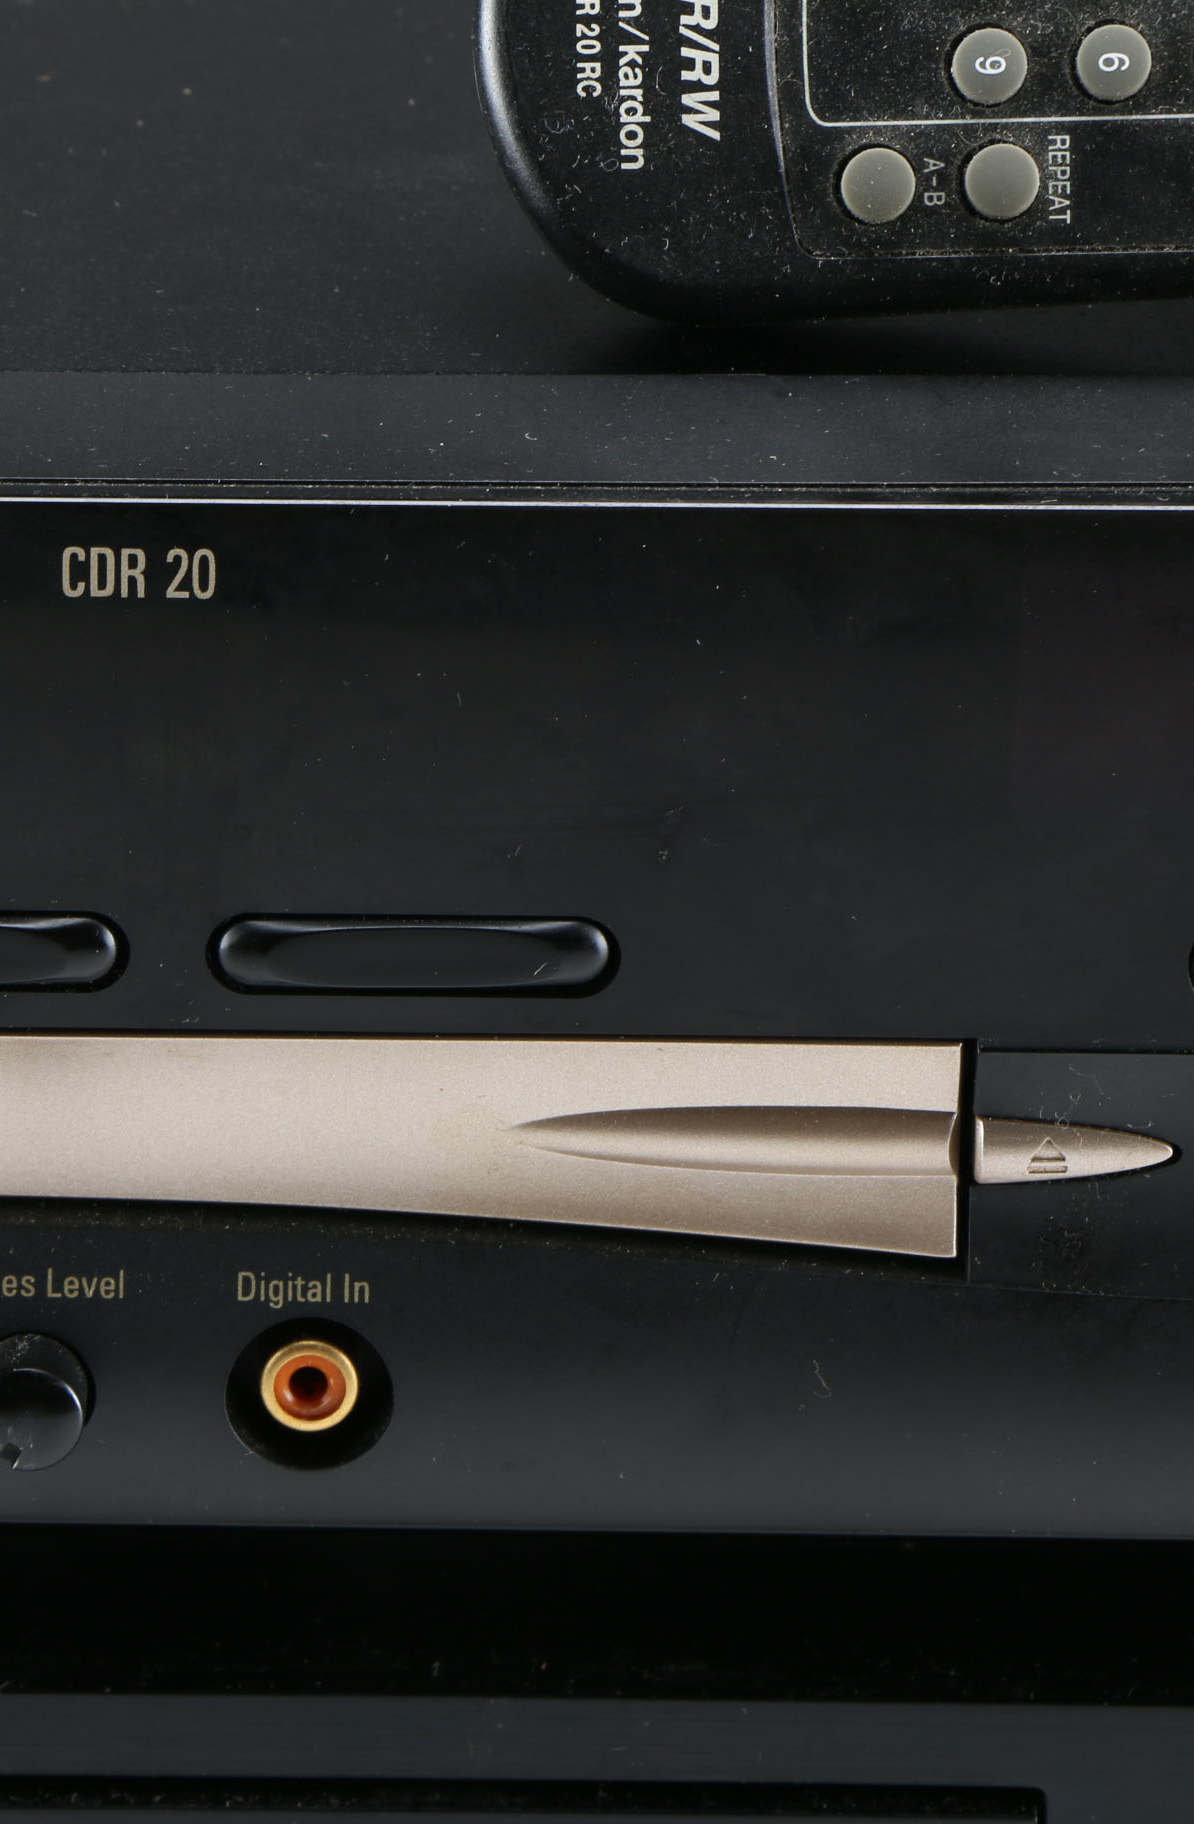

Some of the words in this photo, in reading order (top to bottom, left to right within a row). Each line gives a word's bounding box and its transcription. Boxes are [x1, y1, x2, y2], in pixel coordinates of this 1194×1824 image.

[575, 23, 602, 55] 20
[576, 62, 602, 98] RC
[923, 157, 946, 207] A-B
[1047, 134, 1071, 224] REPEAT
[60, 546, 146, 599] CDR
[165, 548, 217, 601] 20
[46, 1267, 125, 1299] Level
[237, 1271, 332, 1309] Digital
[343, 1273, 370, 1304] In
